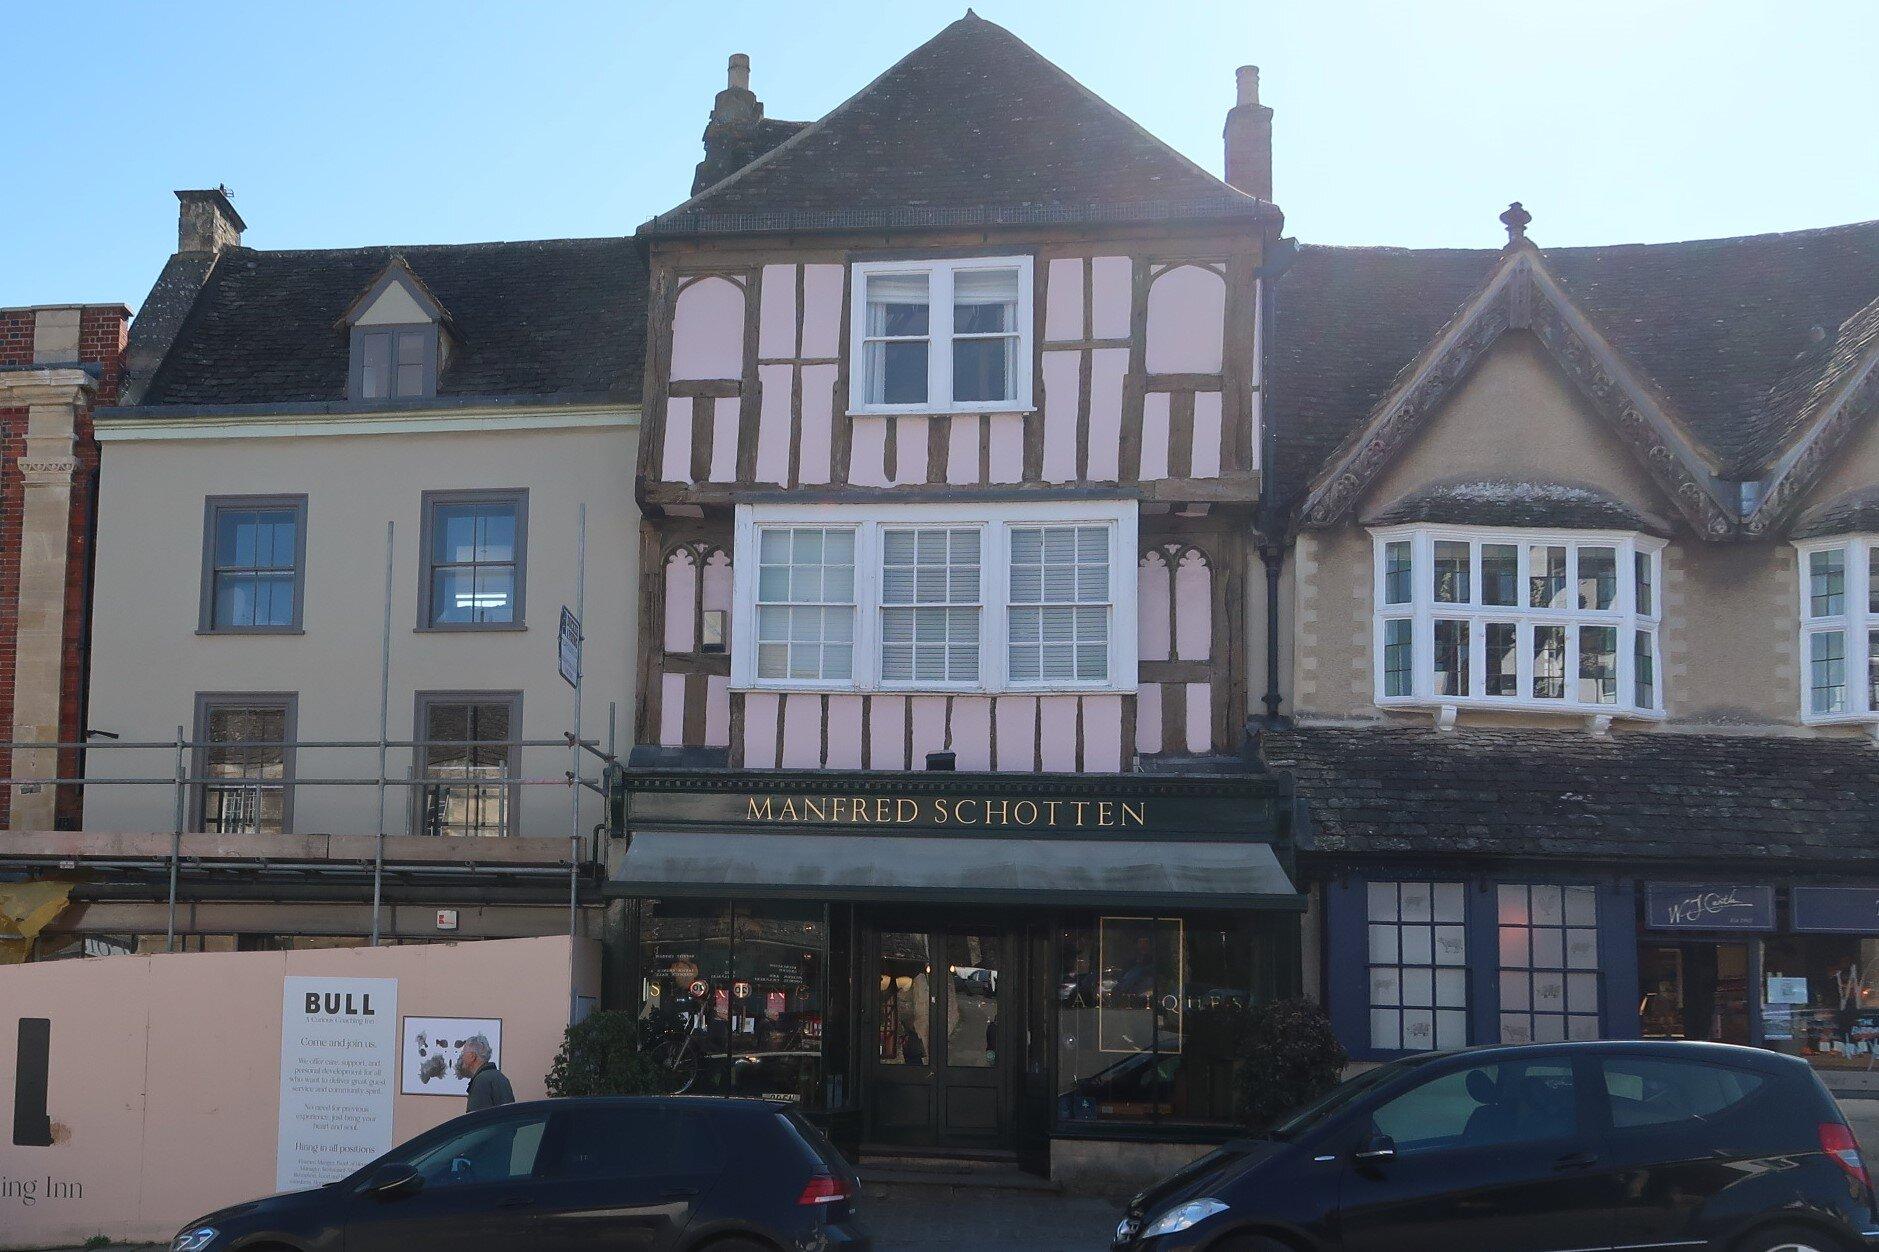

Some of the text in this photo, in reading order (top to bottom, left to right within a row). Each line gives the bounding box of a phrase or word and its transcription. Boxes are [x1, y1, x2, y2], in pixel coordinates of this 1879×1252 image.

[746, 797, 1146, 827] MANFRED SCHOTTEN
[305, 992, 375, 1015] BULL
[300, 1037, 327, 1047] Come
[328, 1038, 345, 1047] and
[345, 1039, 363, 1049] join
[295, 1142, 376, 1155] Hiring in all positions
[2, 1176, 84, 1207] ing Inn
